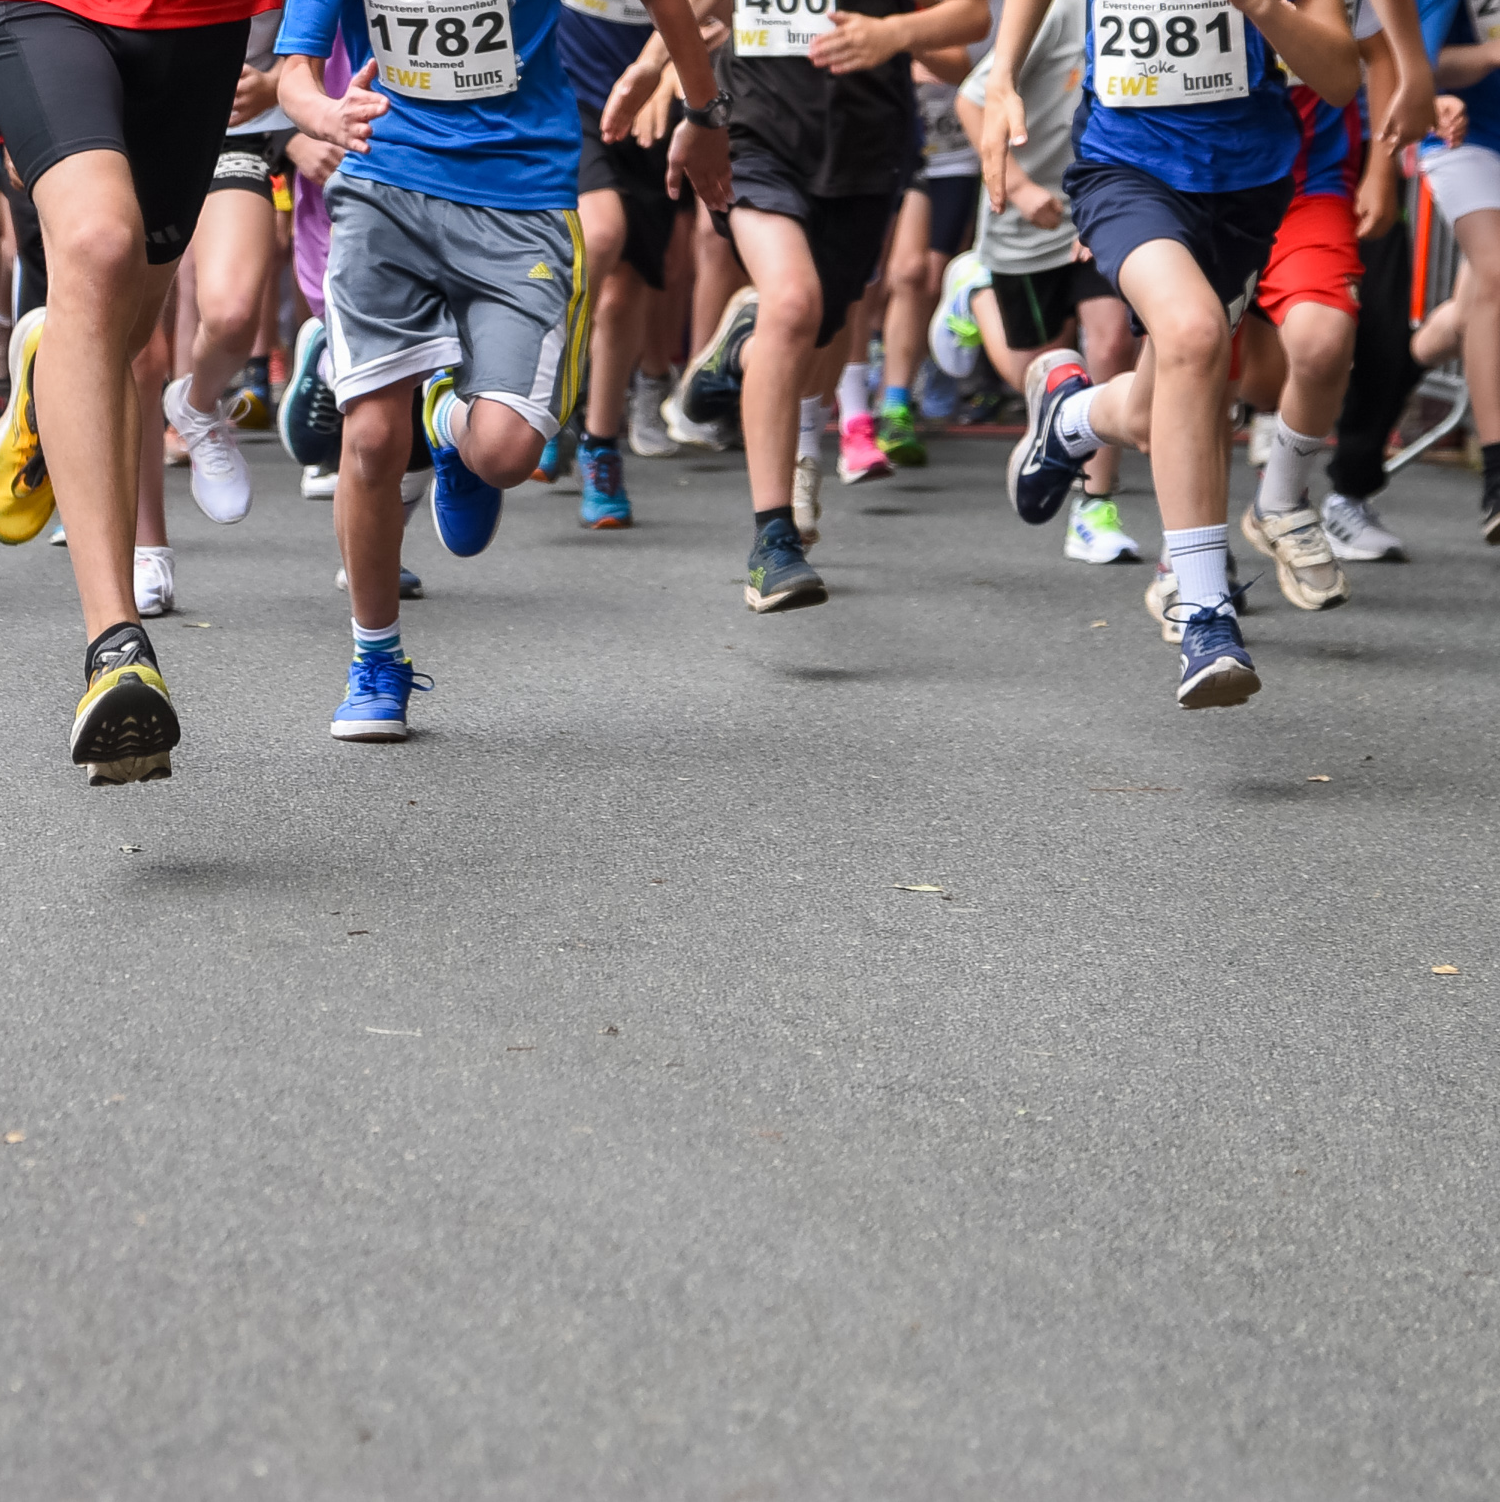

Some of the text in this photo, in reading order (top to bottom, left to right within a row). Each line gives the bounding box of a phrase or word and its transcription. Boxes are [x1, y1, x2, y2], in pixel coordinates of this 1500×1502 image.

[368, 0, 425, 14] Everstener
[1103, 1, 1157, 11] Everstener
[370, 11, 508, 57] 1782
[787, 29, 818, 45] bru
[1100, 11, 1233, 59] 2981
[409, 59, 465, 69] Mohamed
[1135, 59, 1179, 79] Joke
[386, 65, 504, 90] EWE bruns
[1107, 72, 1233, 97] EWE bruns
